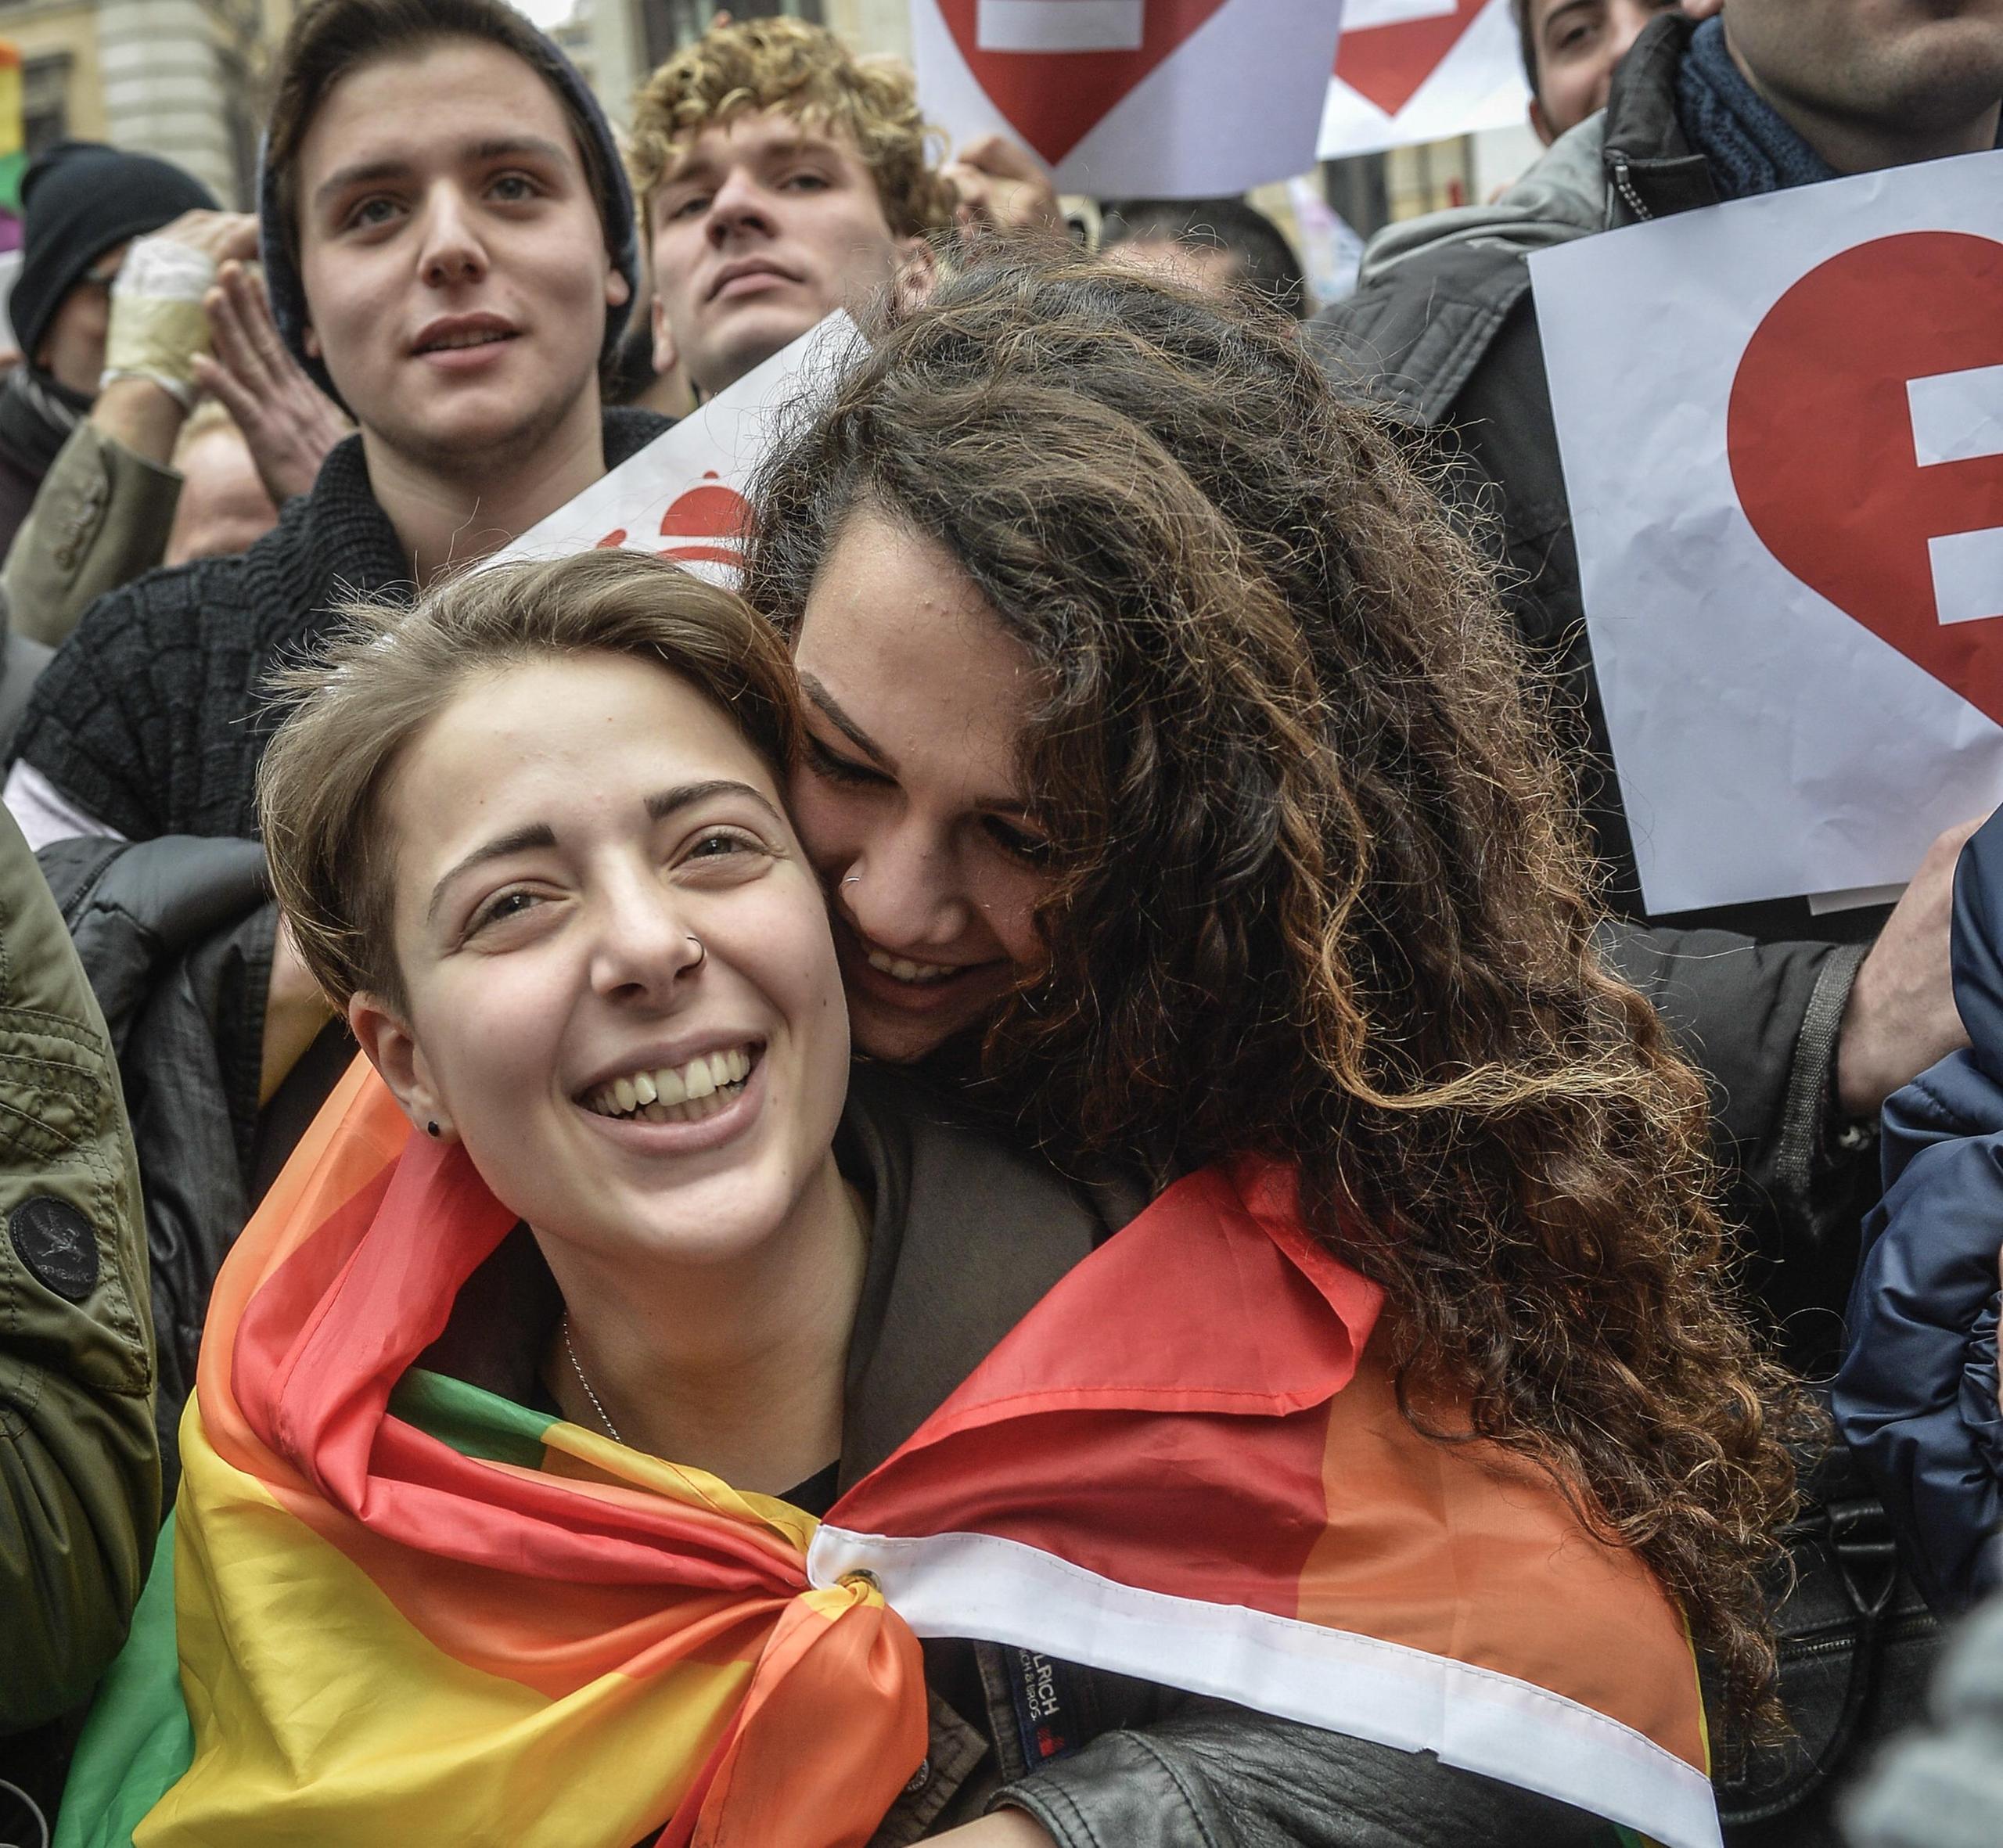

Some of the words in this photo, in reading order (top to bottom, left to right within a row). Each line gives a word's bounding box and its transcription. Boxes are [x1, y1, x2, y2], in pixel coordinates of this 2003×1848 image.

[1019, 1649, 1032, 1672] ICH
[1025, 1674, 1034, 1684] &
[1032, 1652, 1060, 1716] LRICH
